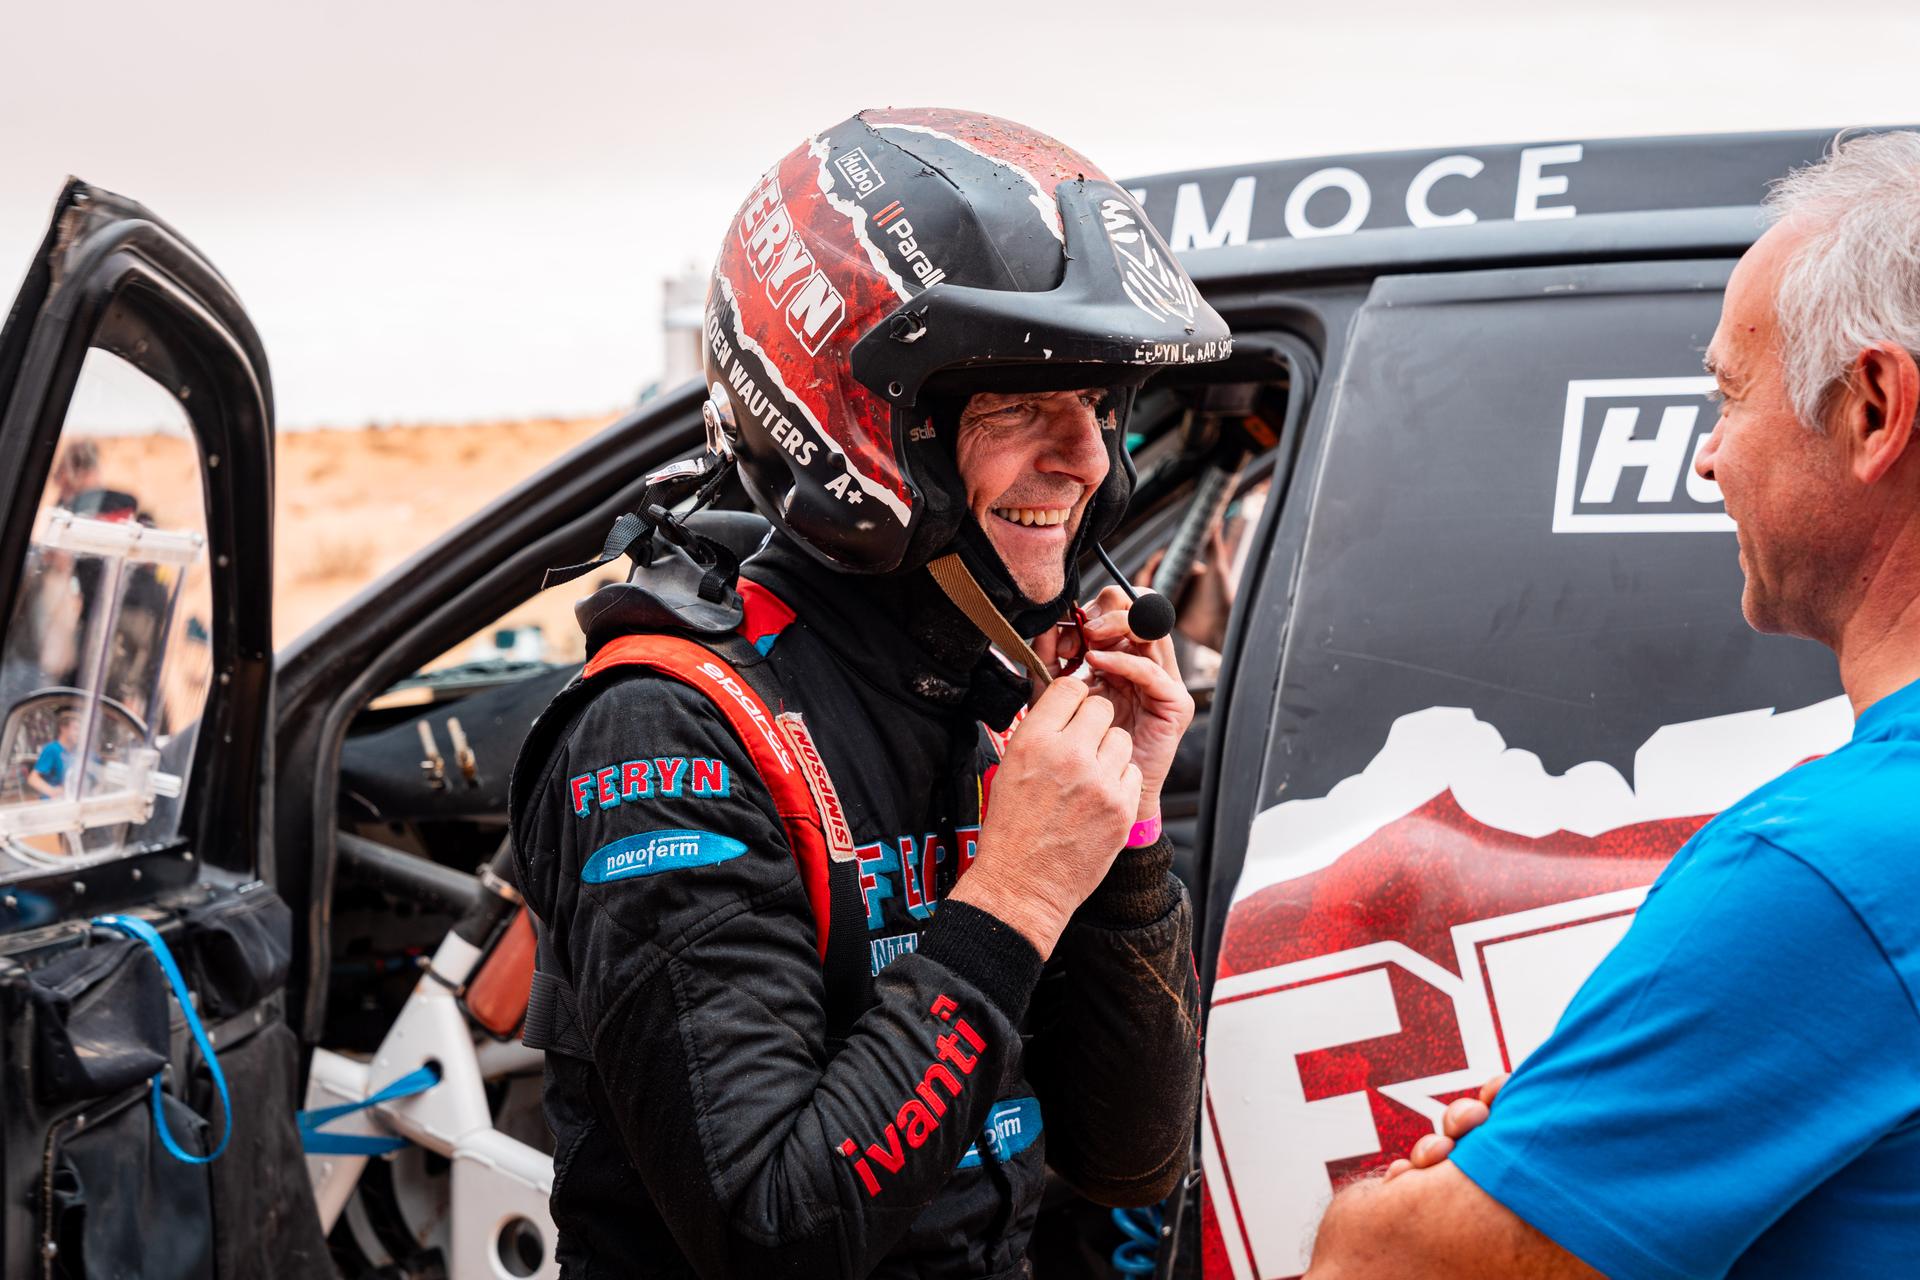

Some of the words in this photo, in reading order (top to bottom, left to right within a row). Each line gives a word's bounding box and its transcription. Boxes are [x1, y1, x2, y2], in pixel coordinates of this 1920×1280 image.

[841, 152, 874, 192] Hubo
[1128, 143, 1584, 252] MOCE
[728, 358, 818, 465] WAUTERS
[824, 473, 863, 504] A+
[571, 757, 730, 818] FERYN
[792, 730, 849, 845] SIMPSON
[606, 839, 699, 871] novoferm
[842, 994, 987, 1197] ivanti
